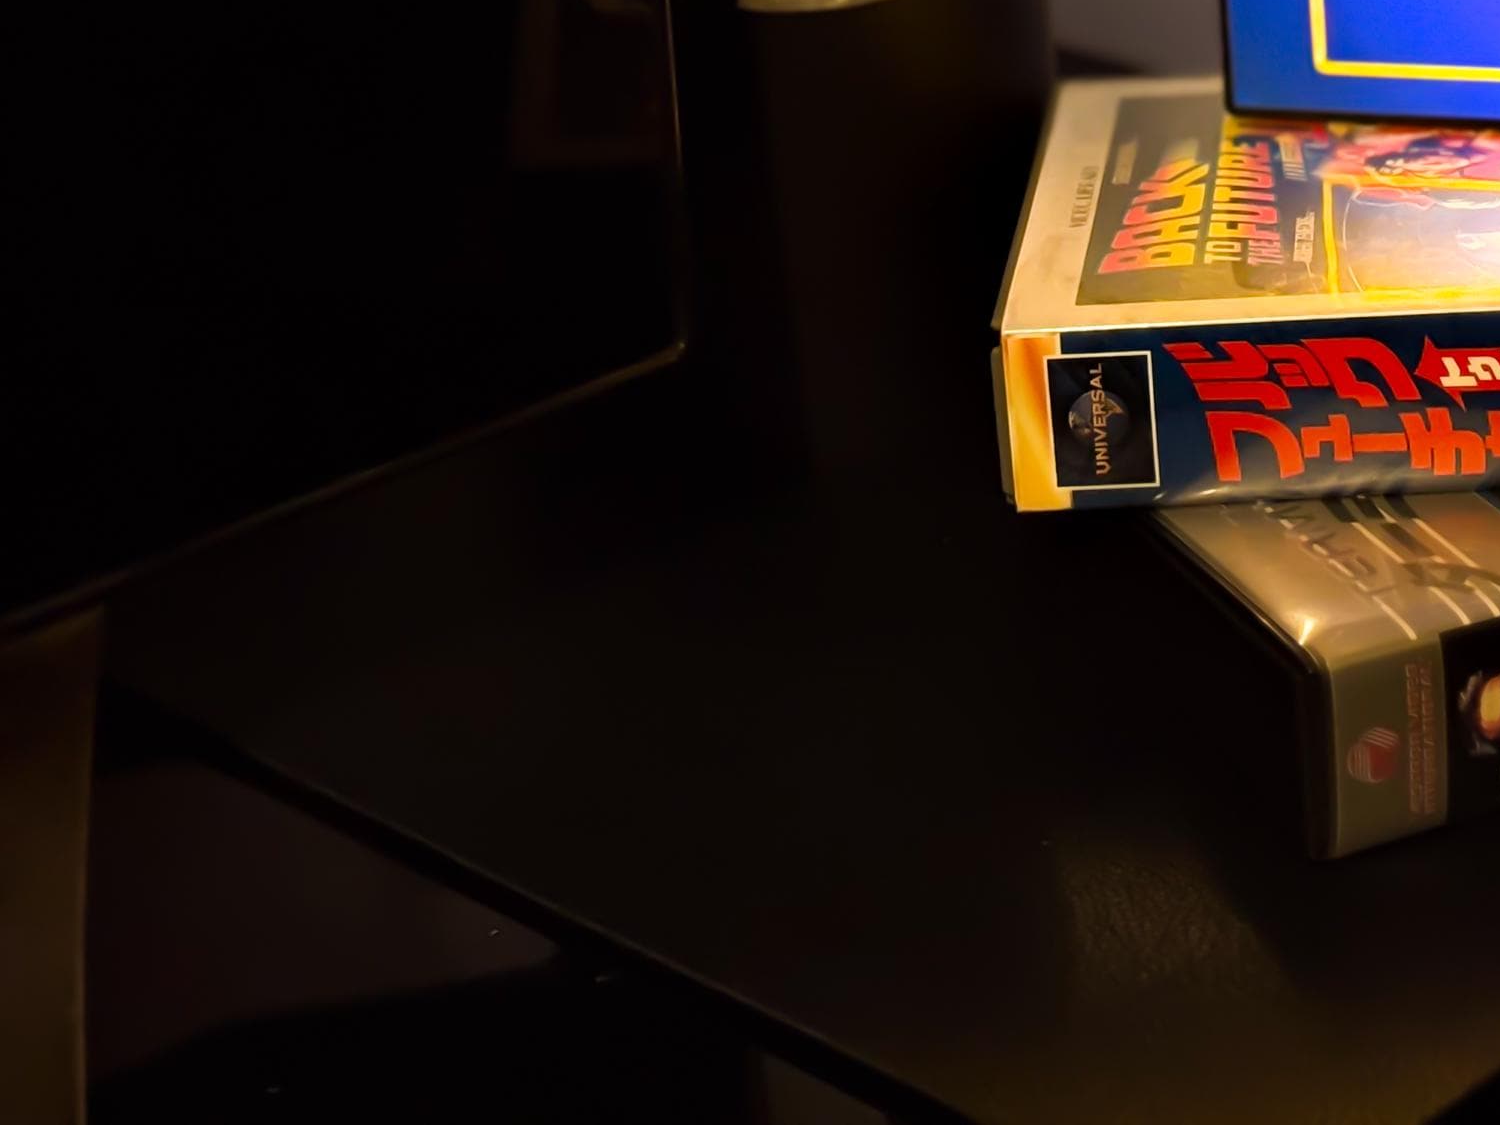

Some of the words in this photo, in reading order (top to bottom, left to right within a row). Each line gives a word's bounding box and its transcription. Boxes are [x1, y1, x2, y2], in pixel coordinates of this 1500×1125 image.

[1098, 160, 1210, 274] BACK
[1209, 140, 1281, 240] FUTURE
[1204, 241, 1242, 264] TO
[1248, 239, 1284, 266] THE
[1161, 335, 1423, 411] バック
[1089, 362, 1112, 476] UNIVERSAL
